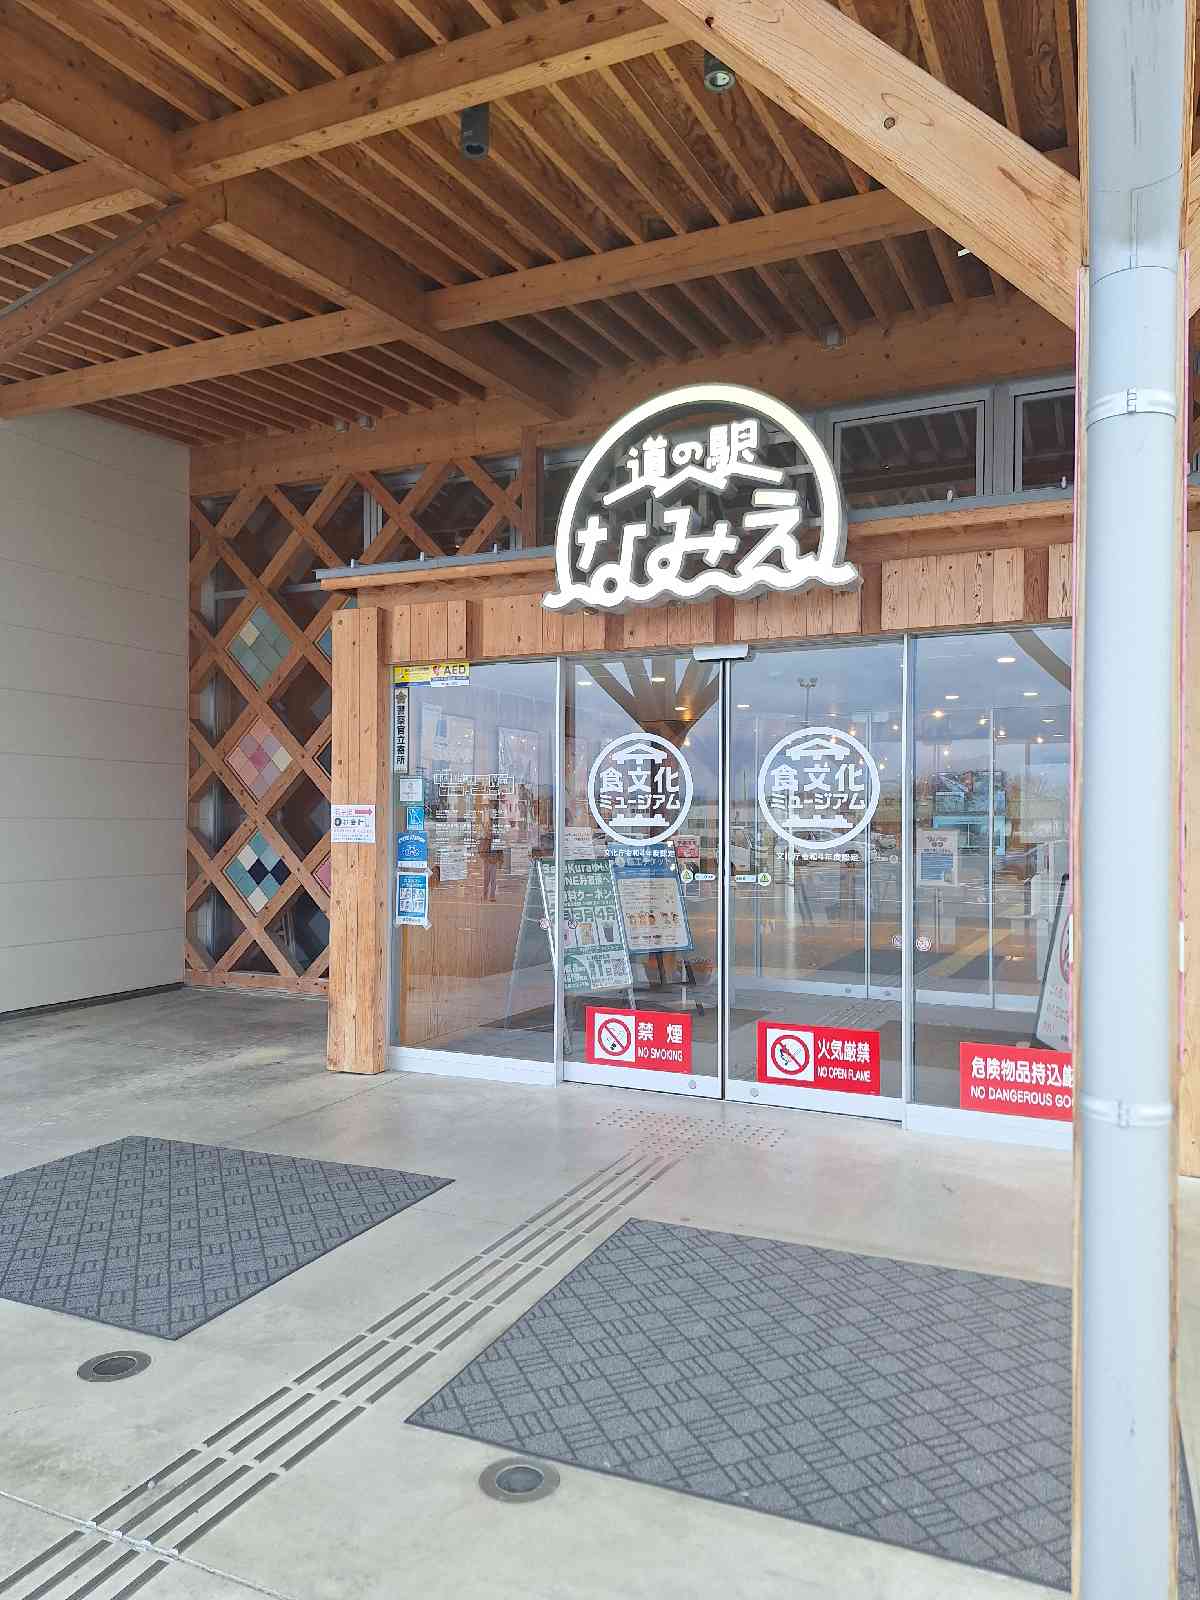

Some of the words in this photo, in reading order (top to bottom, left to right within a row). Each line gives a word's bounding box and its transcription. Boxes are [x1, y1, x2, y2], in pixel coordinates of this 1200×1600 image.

[608, 418, 778, 500] 道の駅
[575, 488, 804, 606] なみえ
[444, 664, 466, 675] AED
[599, 766, 680, 793] 食文化
[770, 763, 865, 792] 食文化
[599, 794, 681, 809] ミュージアム
[770, 793, 866, 810] ミュージアム
[637, 1022, 683, 1045] 禁煙
[638, 1048, 650, 1059] NO
[651, 1049, 683, 1062] SMOKING
[817, 1039, 871, 1064] 火気厳禁
[817, 1067, 828, 1079] NO
[829, 1068, 847, 1081] OPEN
[848, 1070, 871, 1083] FLAME
[970, 1085, 986, 1099] NO
[988, 1087, 1053, 1107] DANGEROUS
[1055, 1094, 1073, 1109] GO
